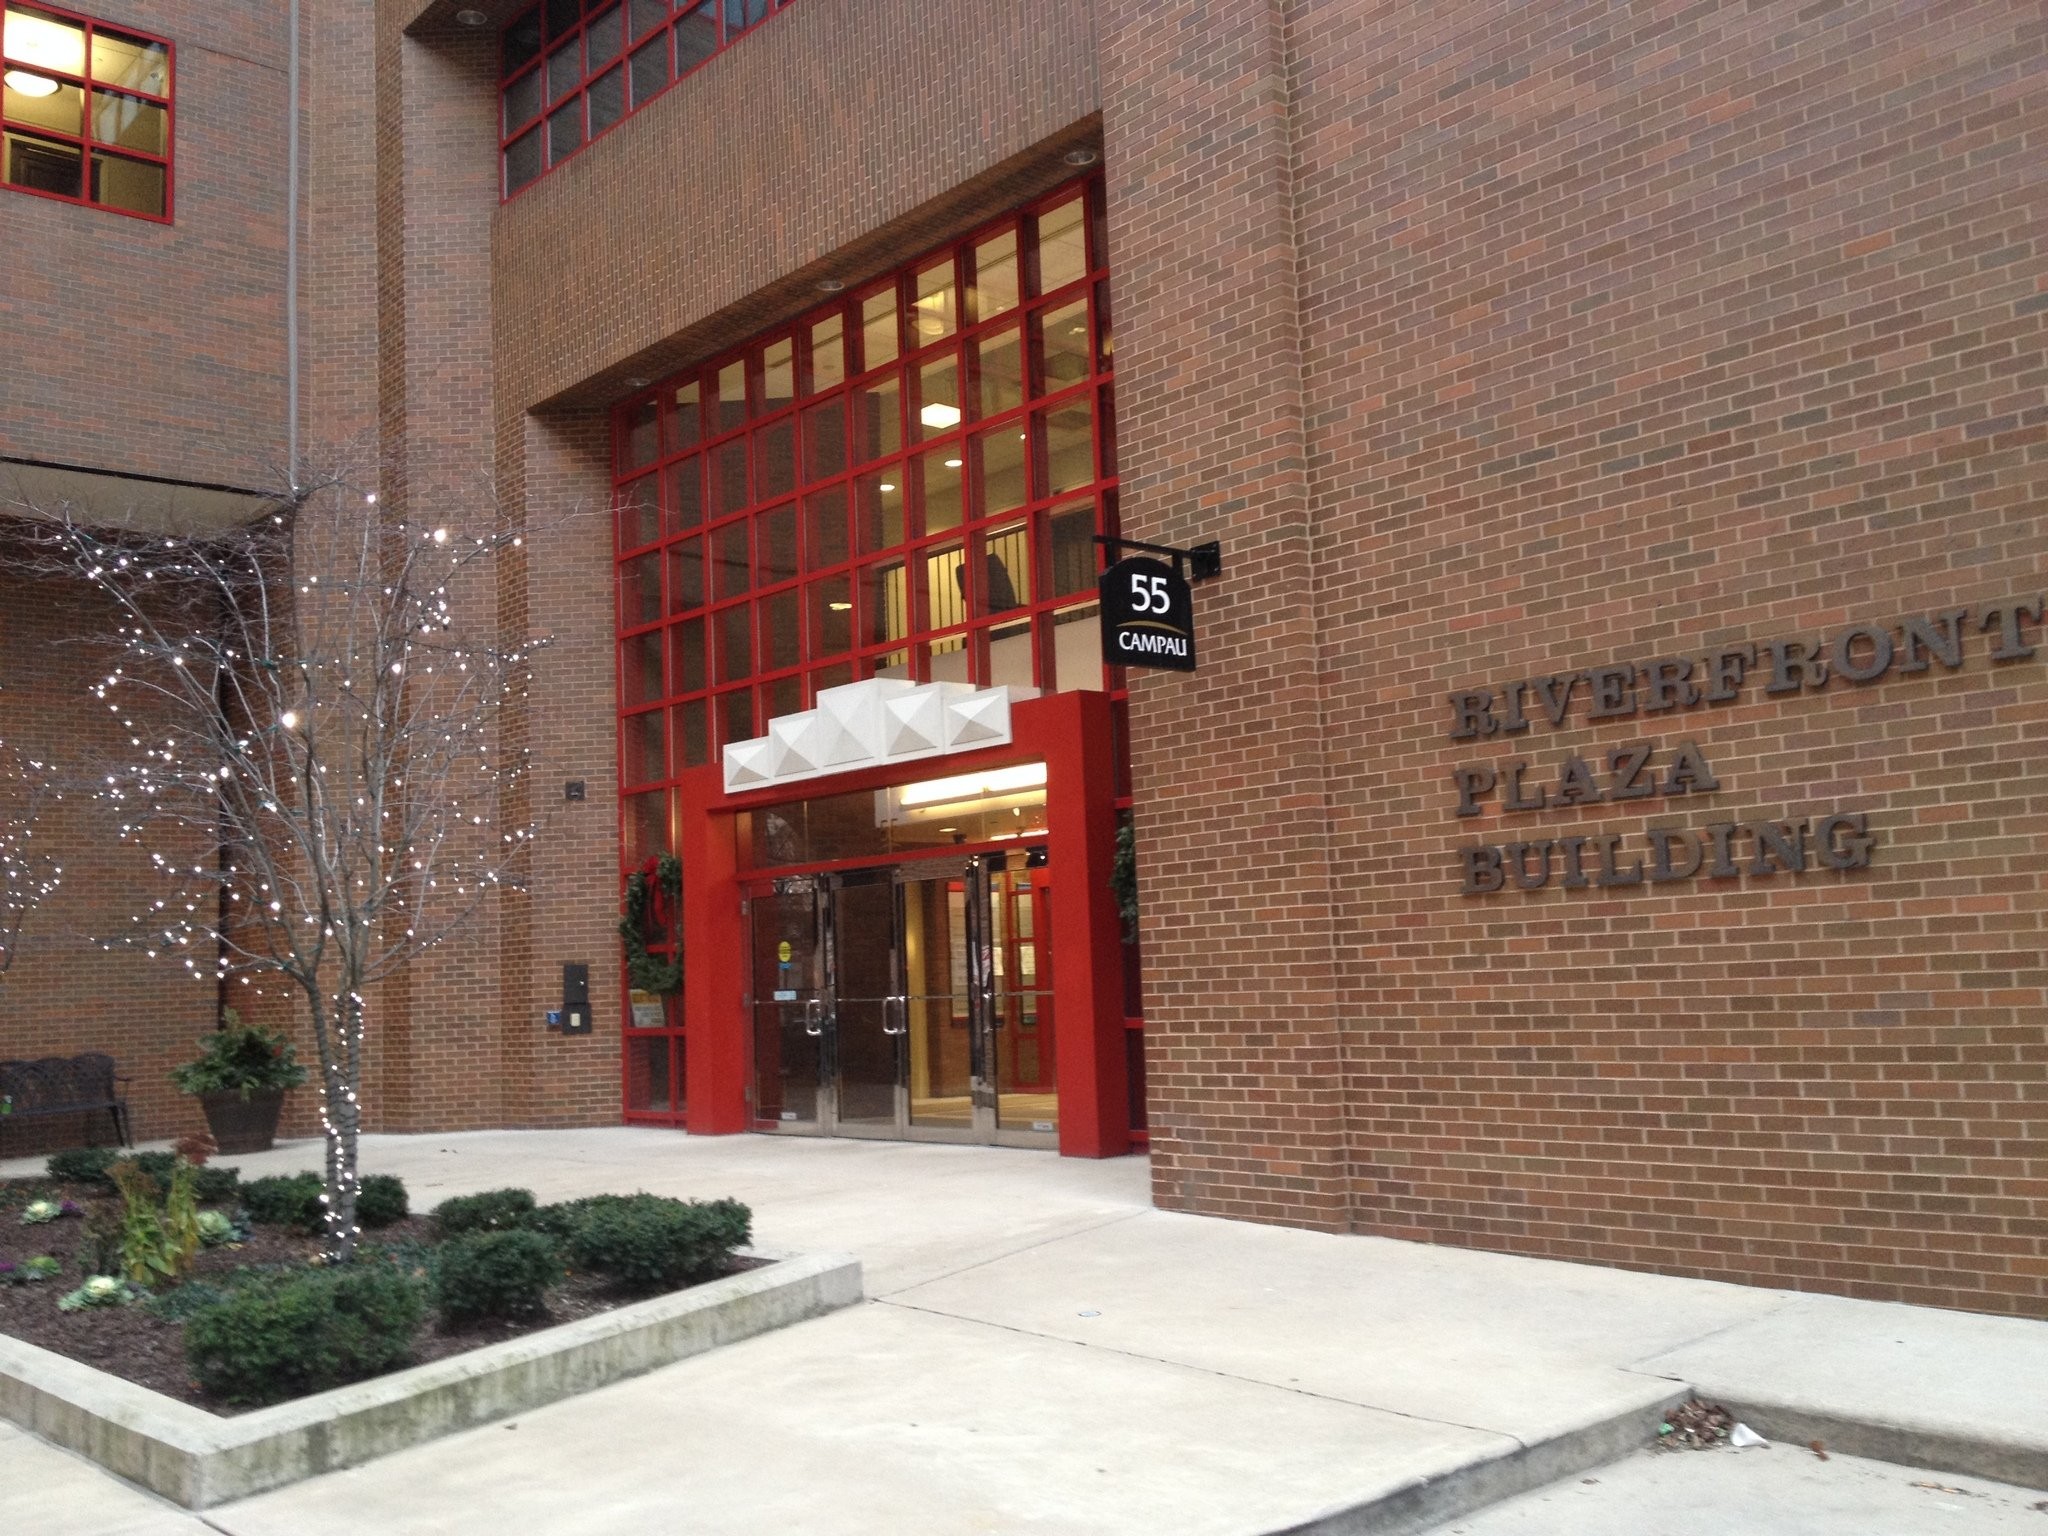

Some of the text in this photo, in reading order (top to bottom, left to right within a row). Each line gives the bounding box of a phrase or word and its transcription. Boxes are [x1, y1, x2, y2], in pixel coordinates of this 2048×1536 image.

[1131, 573, 1171, 614] 55
[1119, 631, 1188, 656] CAMPAU
[1449, 599, 2044, 739] RIVERFRONT
[1453, 741, 1719, 817] PLAZA
[1458, 813, 1876, 895] BUILDING
